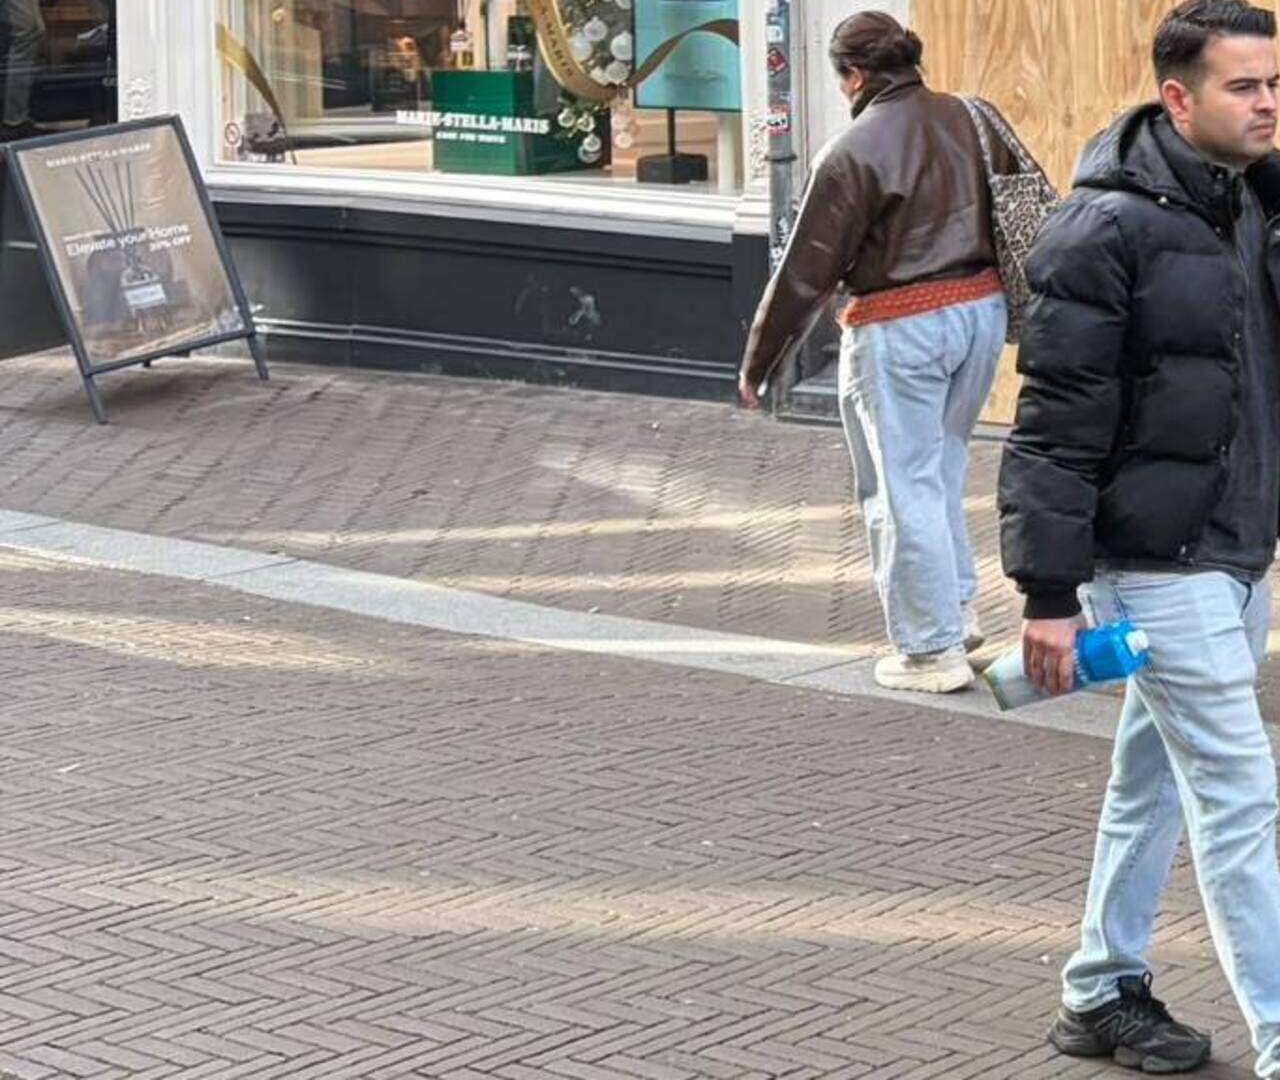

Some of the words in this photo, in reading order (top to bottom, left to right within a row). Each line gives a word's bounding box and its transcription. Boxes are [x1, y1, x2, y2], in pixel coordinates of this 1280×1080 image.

[66, 238, 117, 256] Elevate
[117, 231, 147, 249] your
[146, 223, 190, 240] Home
